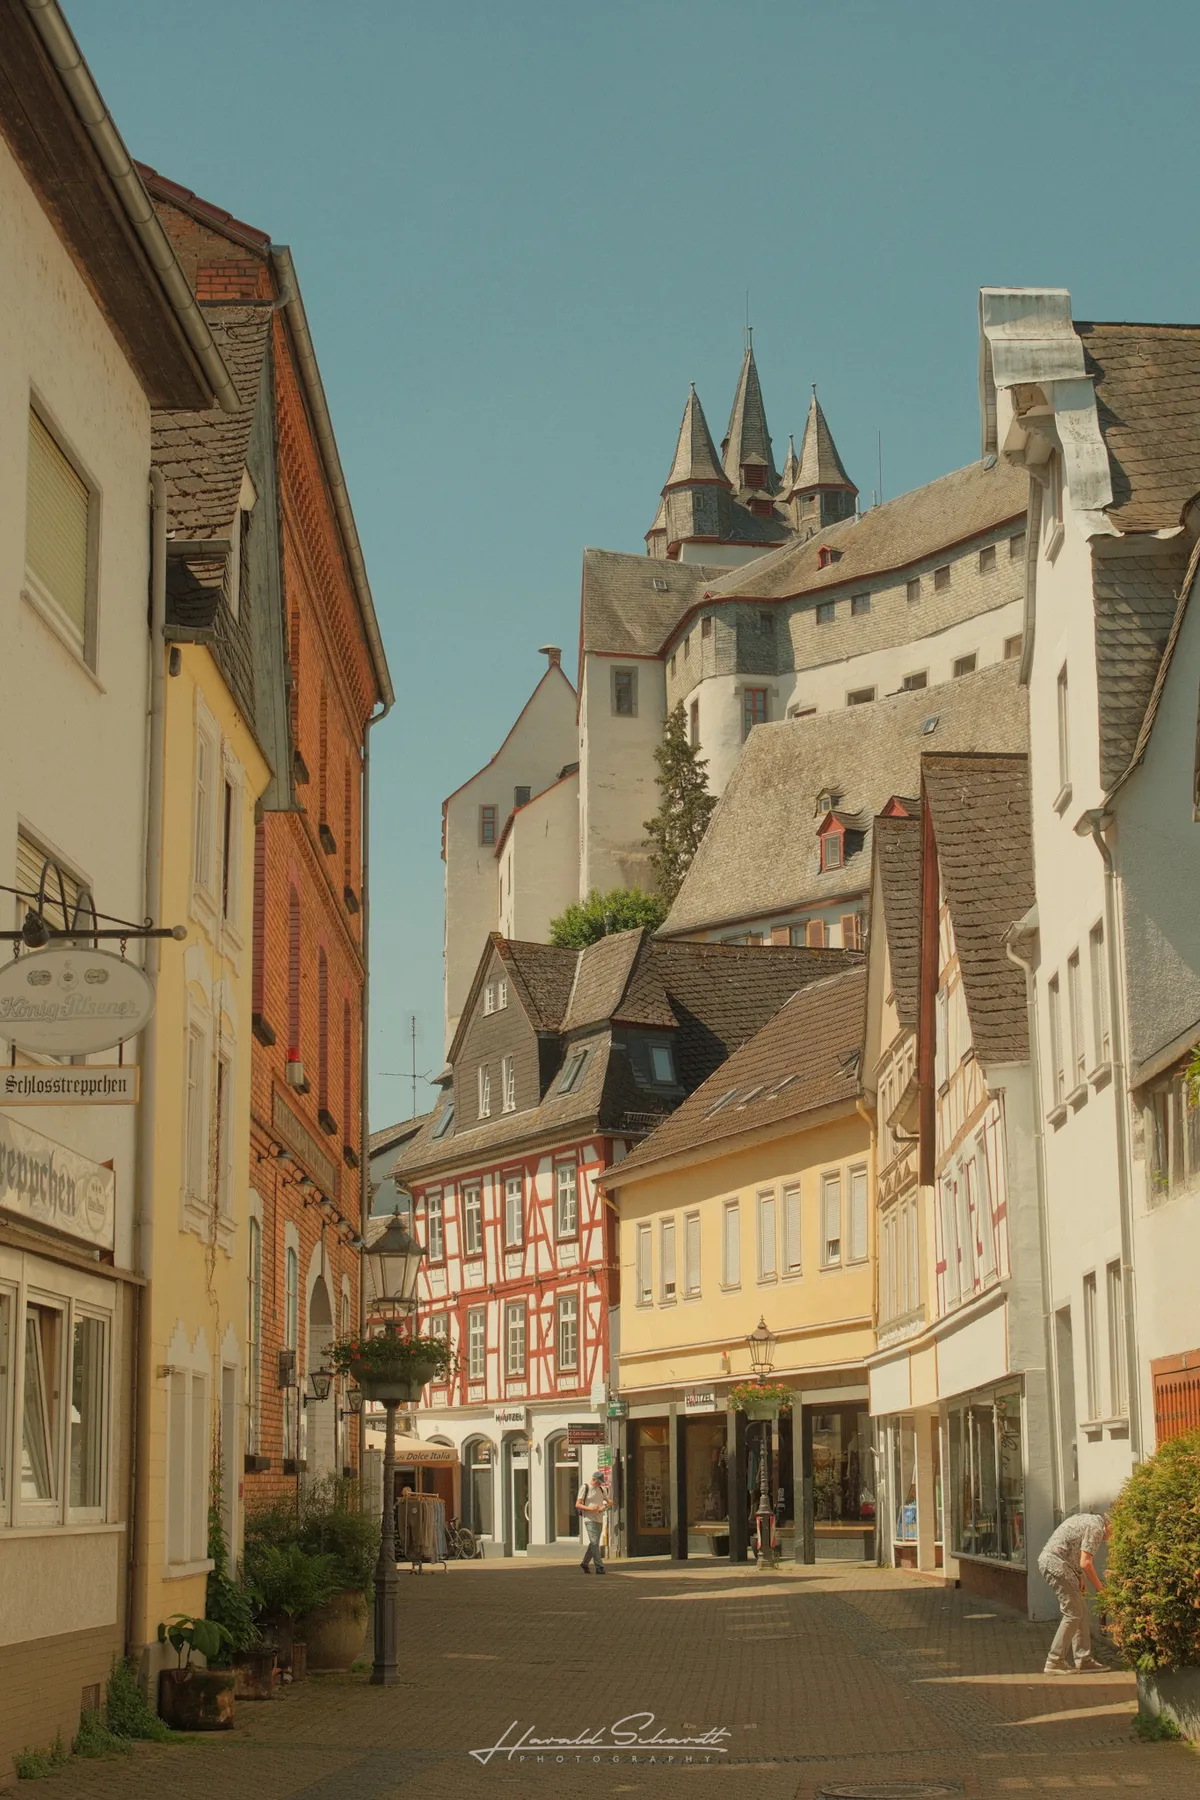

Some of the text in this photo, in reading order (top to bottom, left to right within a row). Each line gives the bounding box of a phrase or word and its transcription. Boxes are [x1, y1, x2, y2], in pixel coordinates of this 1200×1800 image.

[4, 1074, 127, 1097] Schlosstreppchen
[406, 1452, 429, 1460] Dolce
[430, 1451, 451, 1460] Italia
